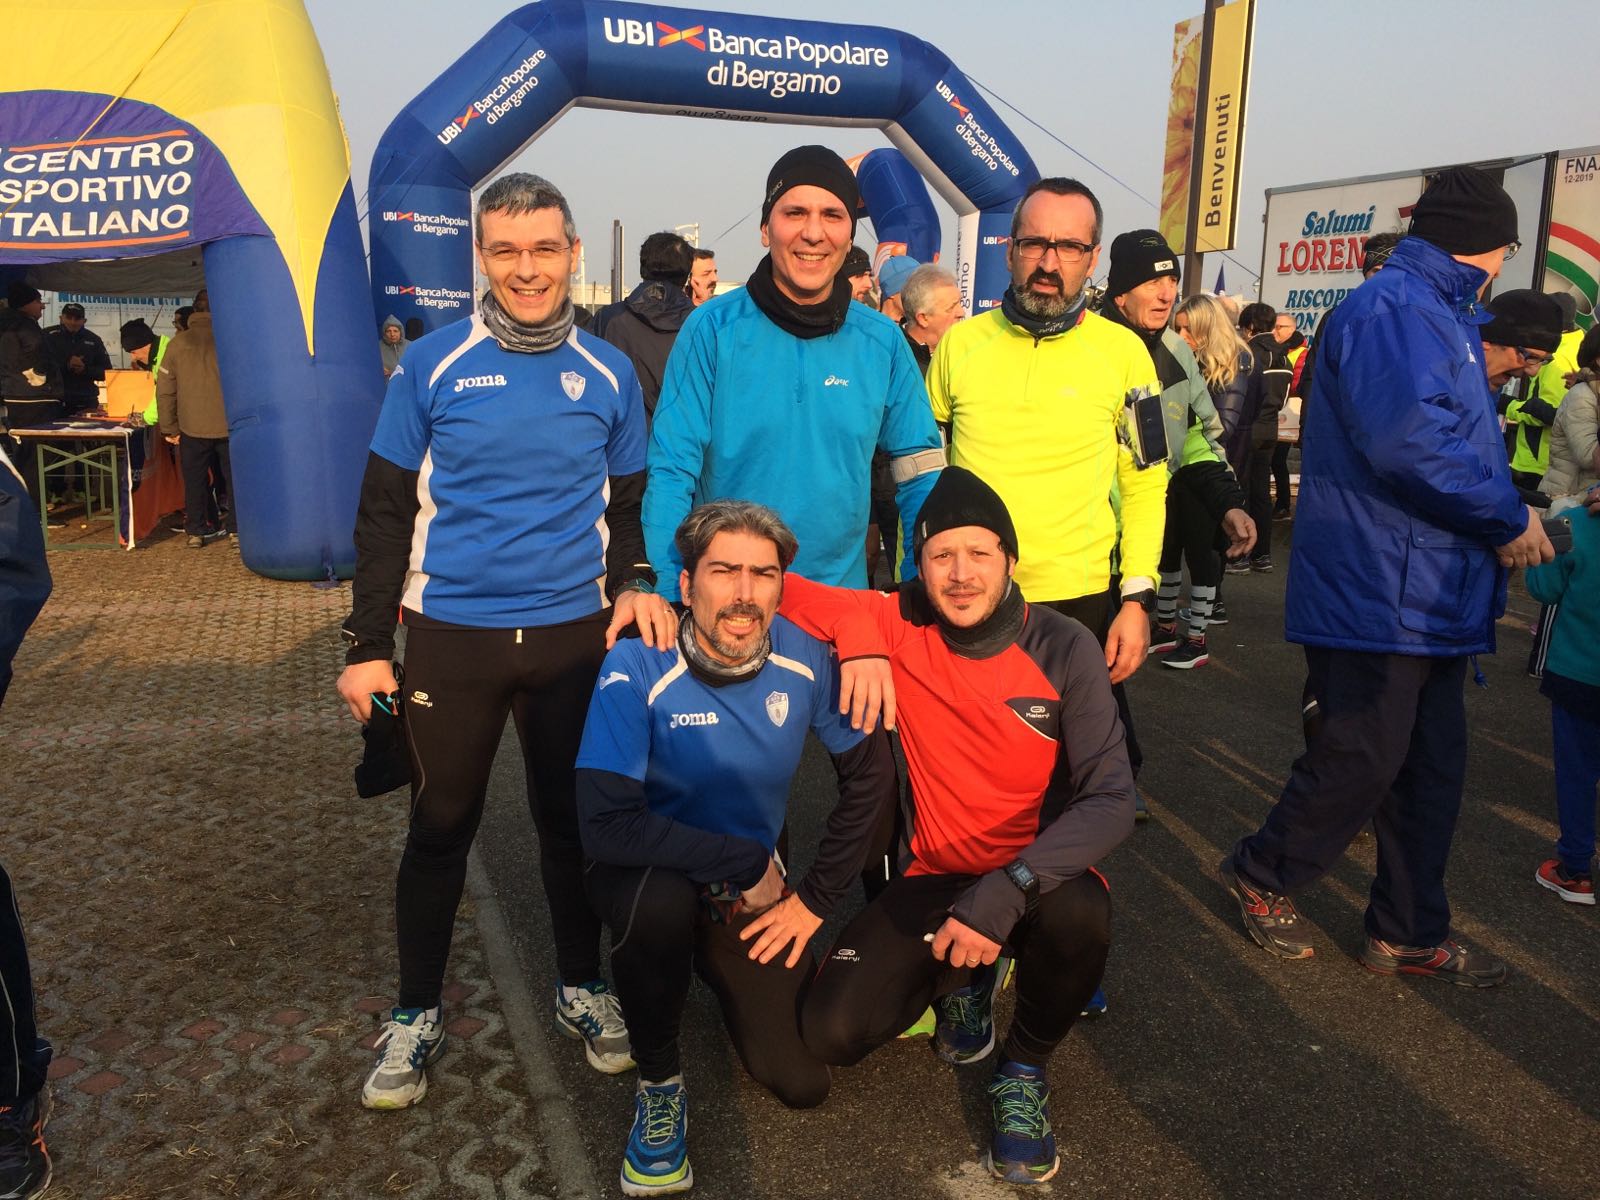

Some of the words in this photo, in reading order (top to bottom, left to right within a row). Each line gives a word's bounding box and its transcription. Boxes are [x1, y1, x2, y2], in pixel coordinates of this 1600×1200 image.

[603, 17, 654, 47] UBI
[708, 28, 782, 59] Banca
[785, 36, 889, 68] Popolare
[707, 60, 728, 86] di
[732, 61, 841, 98] Bergamo
[437, 122, 462, 145] UBI
[473, 84, 507, 114] Banca
[501, 49, 546, 89] Popolare
[493, 76, 539, 117] Bergamo
[936, 80, 955, 102] UBI
[964, 113, 989, 142] Banca
[986, 137, 1020, 176] Popolare
[3, 140, 194, 174] CENTRO
[962, 129, 998, 170] Bergamo
[1205, 93, 1231, 227] Benvenuti
[1565, 156, 1600, 174] FNA
[0, 171, 192, 204] SPORTIVO
[1564, 173, 1594, 183] 12-2019
[383, 212, 397, 221] UBI
[413, 213, 439, 224] Banca
[440, 215, 469, 227] Popolare
[423, 224, 459, 236] Bergamo
[1302, 205, 1376, 236] Salumi
[983, 236, 997, 245] UBI
[385, 286, 398, 295] UBI
[415, 287, 440, 297] Banca
[442, 288, 470, 299] Popolare
[424, 298, 460, 309] Bergamo
[979, 299, 992, 307] UBI
